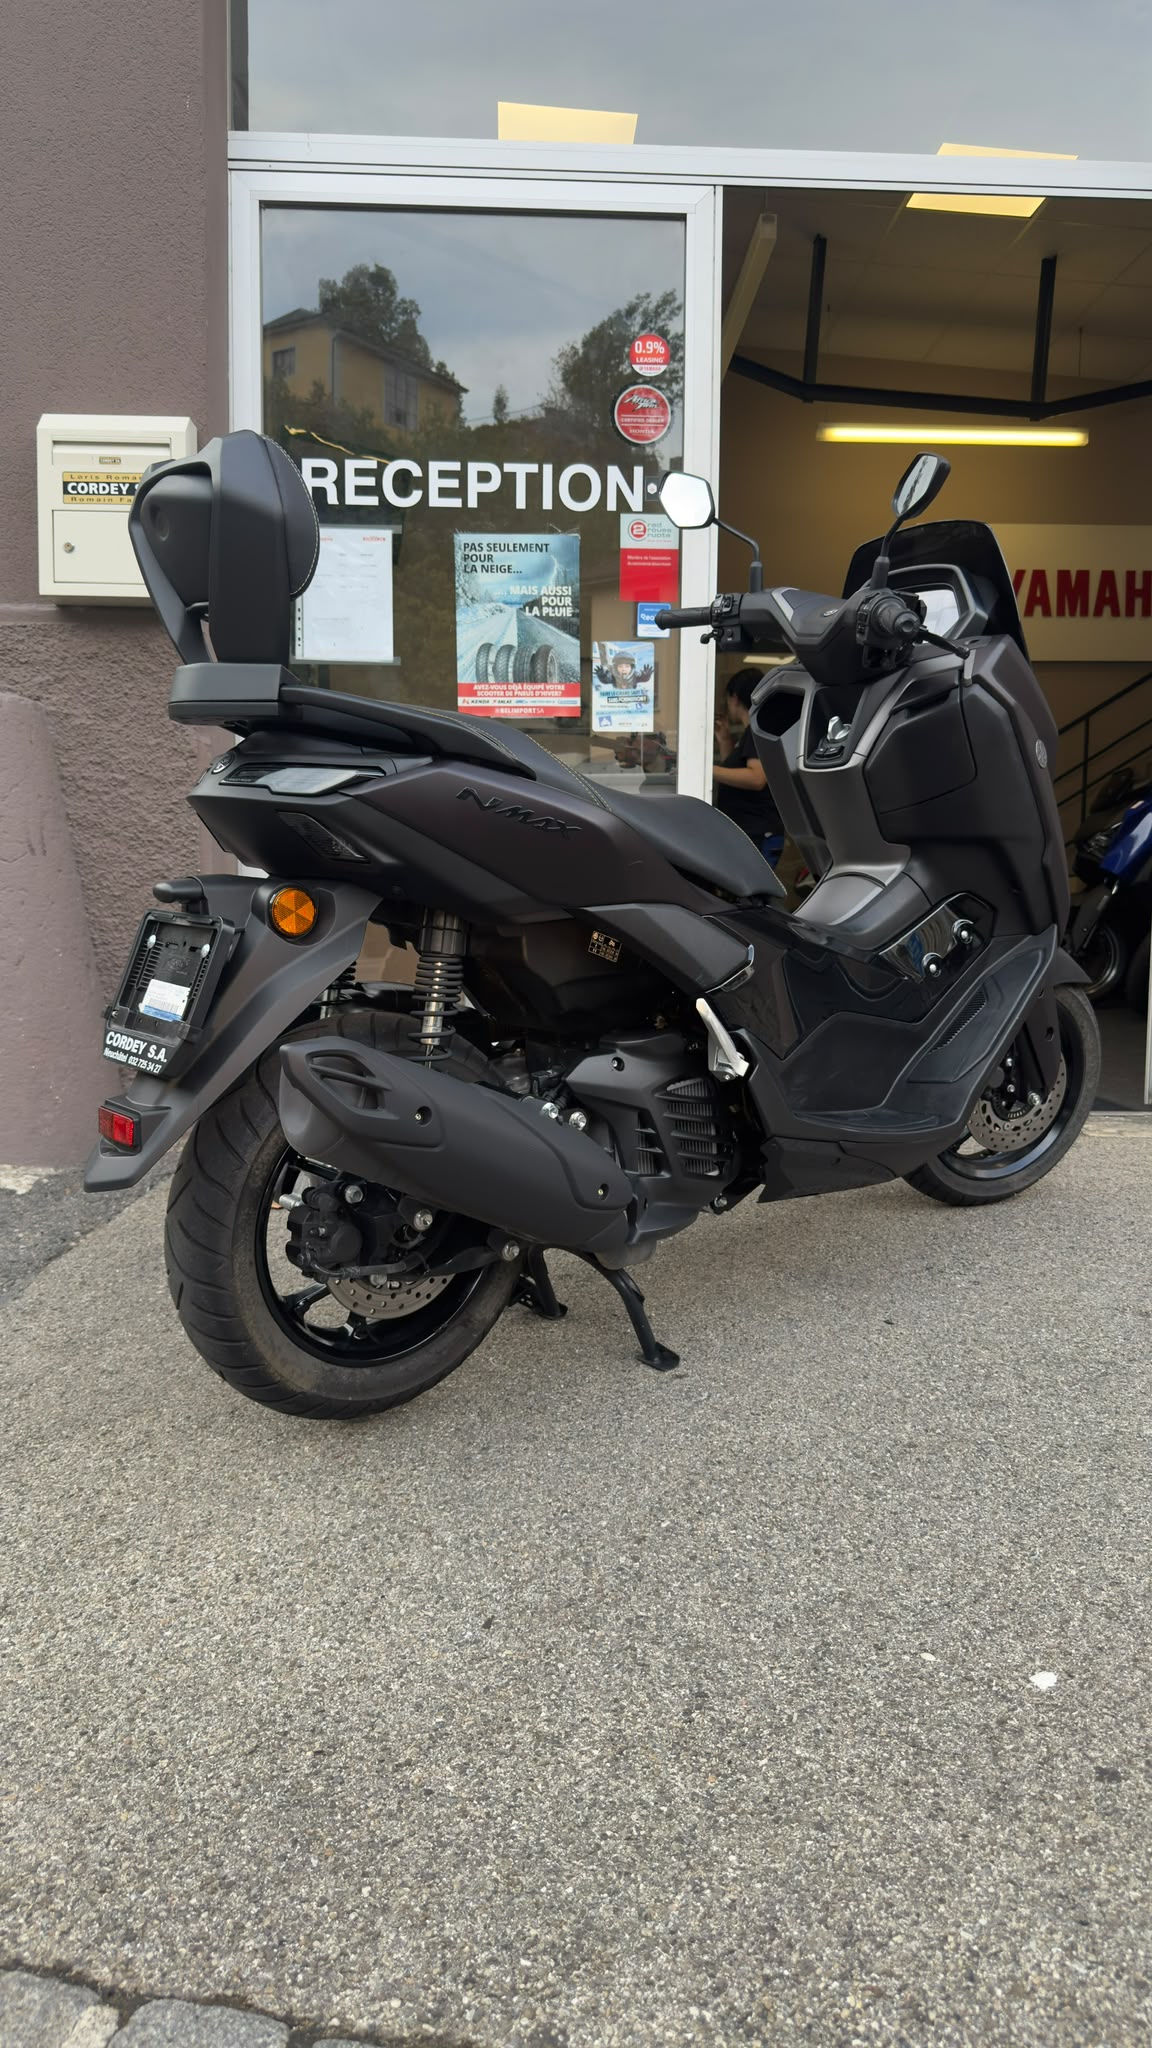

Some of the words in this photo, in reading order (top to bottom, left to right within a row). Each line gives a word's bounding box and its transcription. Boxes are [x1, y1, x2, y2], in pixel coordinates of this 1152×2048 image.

[635, 341, 665, 354] 0.9%
[67, 482, 129, 495] CORDEY
[301, 458, 644, 512] RECEPTION
[463, 542, 484, 553] PAS
[486, 543, 550, 553] SEULEMENT
[463, 553, 494, 563] POUR
[463, 564, 478, 574] LA
[510, 585, 538, 595] MAIS
[540, 585, 572, 596] AUSSI
[541, 596, 573, 607] POUR
[525, 606, 540, 617] LA
[542, 606, 573, 617] PLUIE
[456, 786, 583, 840] NMAX
[105, 1031, 148, 1055] CORDEY
[147, 1044, 168, 1063] S.A.
[128, 1055, 139, 1066] 032
[138, 1058, 148, 1069] 725
[146, 1061, 155, 1072] 34
[153, 1063, 162, 1074] 27
